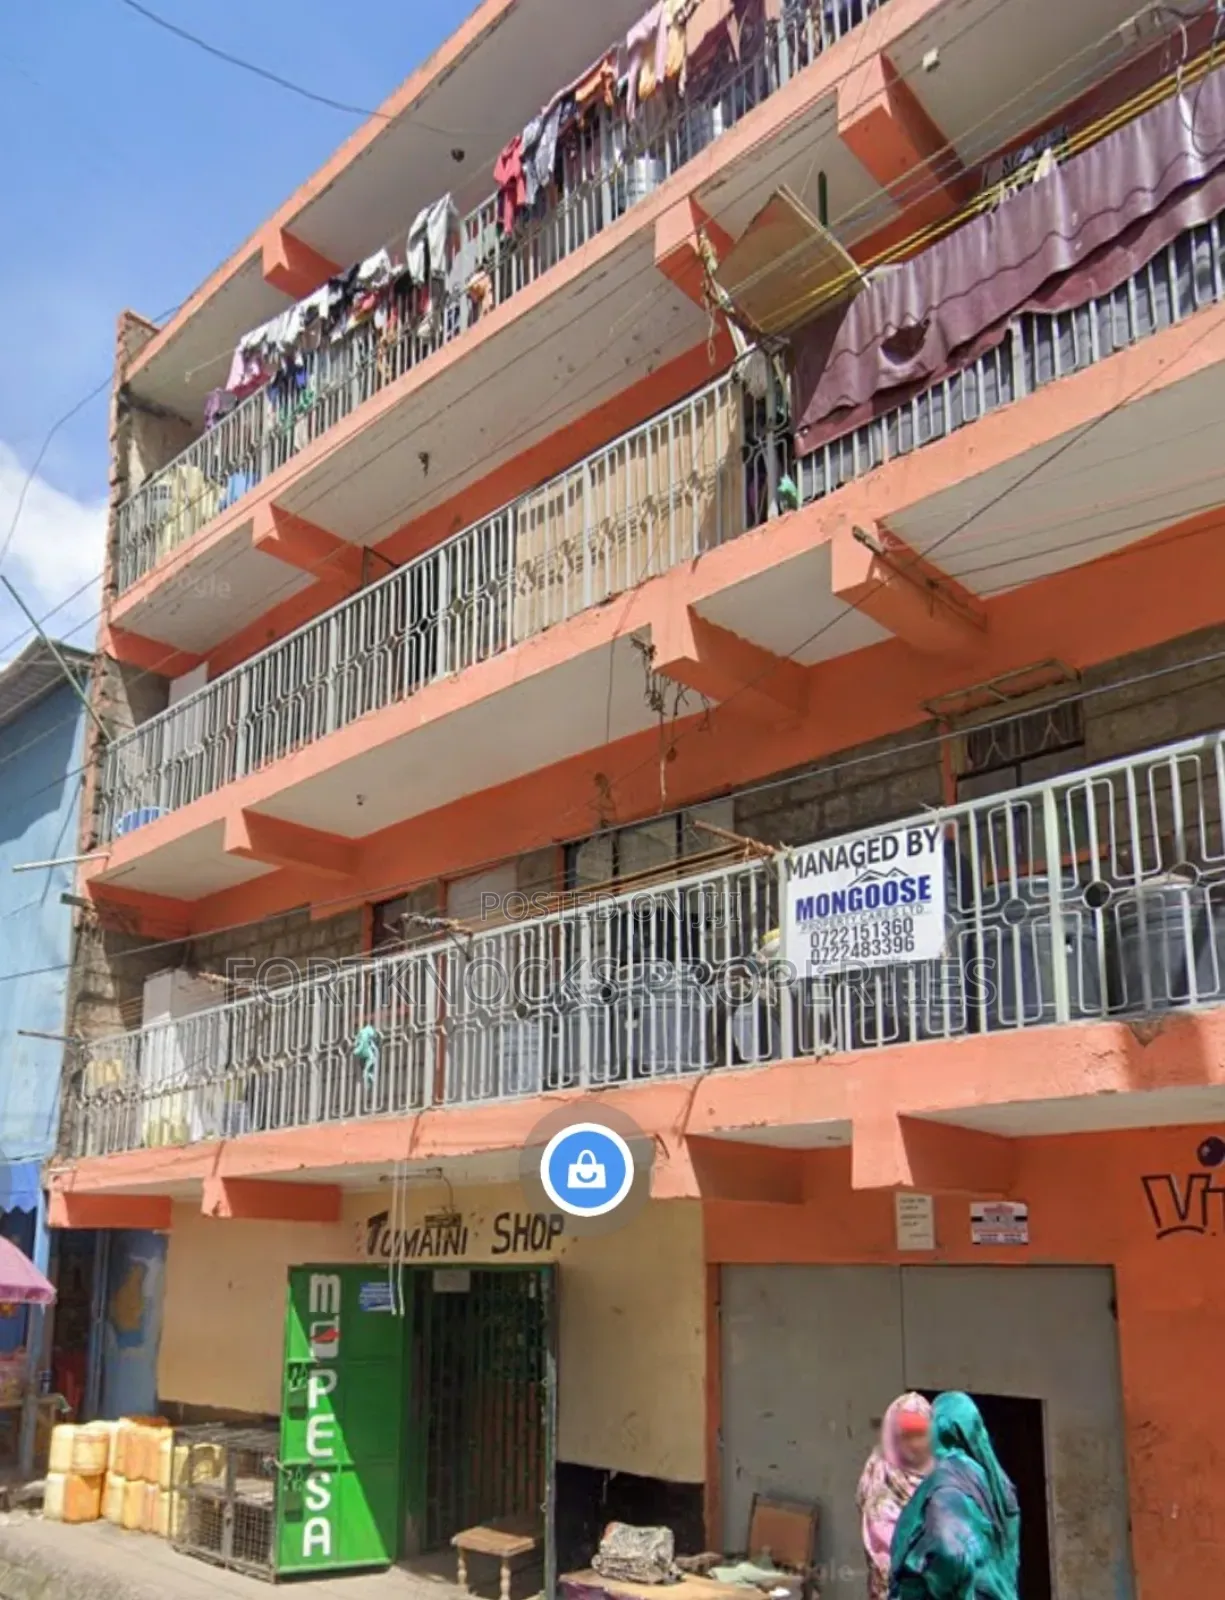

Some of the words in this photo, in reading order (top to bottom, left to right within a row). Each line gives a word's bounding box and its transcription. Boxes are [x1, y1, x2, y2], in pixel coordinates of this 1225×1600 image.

[785, 834, 899, 881] MANAGED
[906, 827, 939, 857] BY
[795, 876, 931, 921] MONGOOSE
[810, 917, 914, 949] 0722151360
[810, 935, 915, 966] 0722483396
[491, 1212, 565, 1255] SHOP
